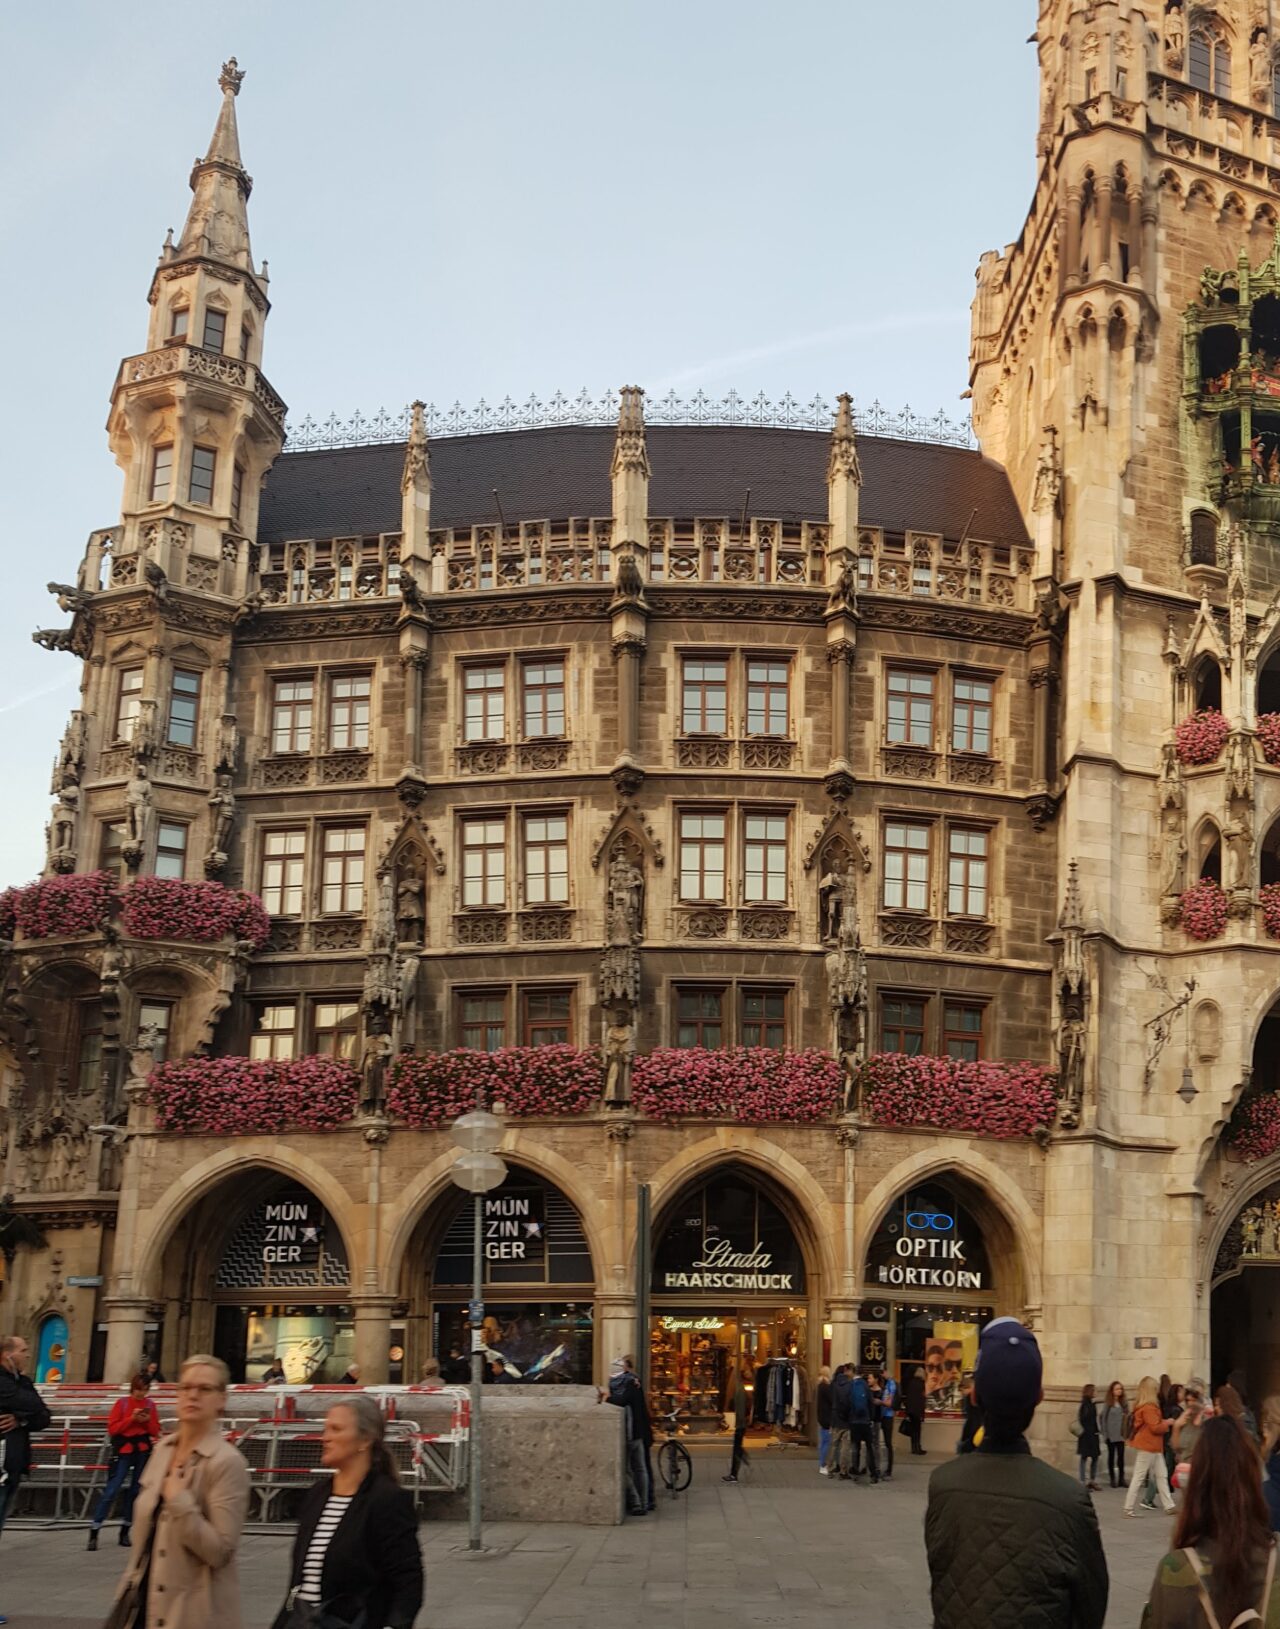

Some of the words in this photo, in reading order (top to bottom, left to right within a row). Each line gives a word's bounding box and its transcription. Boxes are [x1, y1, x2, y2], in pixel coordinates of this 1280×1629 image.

[265, 1201, 308, 1220] MÜN
[485, 1197, 529, 1216] MÜN
[264, 1225, 296, 1241] ZIN
[486, 1221, 519, 1238] ZIN
[263, 1246, 301, 1262] GER
[485, 1242, 525, 1259] GER
[691, 1237, 773, 1268] Linda
[895, 1237, 966, 1261] OPTIK
[664, 1273, 793, 1290] HAARSCHMUCK
[879, 1264, 981, 1289] HÖRTKORN
